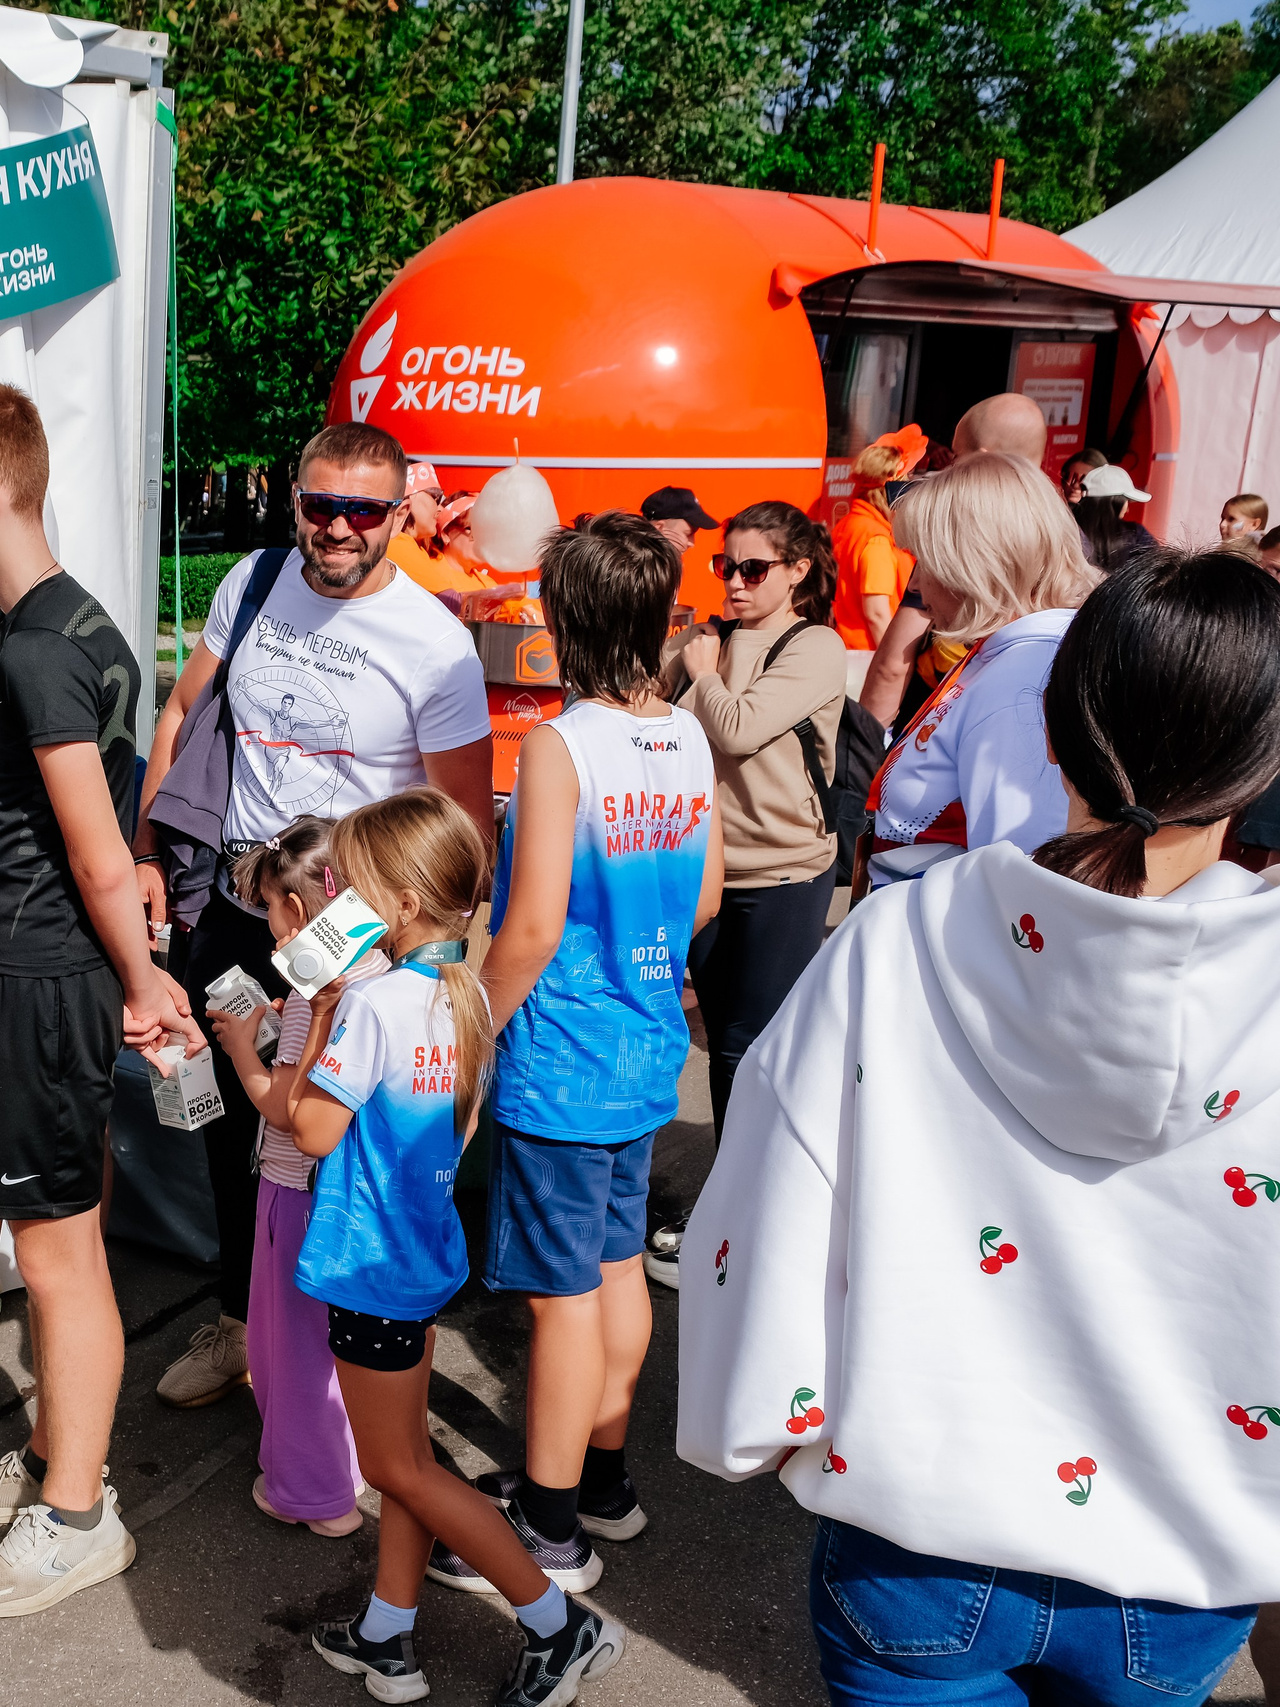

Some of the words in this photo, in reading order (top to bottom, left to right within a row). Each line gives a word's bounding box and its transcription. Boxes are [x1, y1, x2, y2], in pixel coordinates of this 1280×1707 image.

[15, 140, 97, 201] КУХНЯ
[400, 345, 526, 377] ОГОНЬ
[390, 380, 542, 417] ЖИЗНИ
[258, 614, 297, 644] БУДЬ
[321, 917, 348, 946] ПРОСТО
[187, 1091, 211, 1107] ПРОСТО
